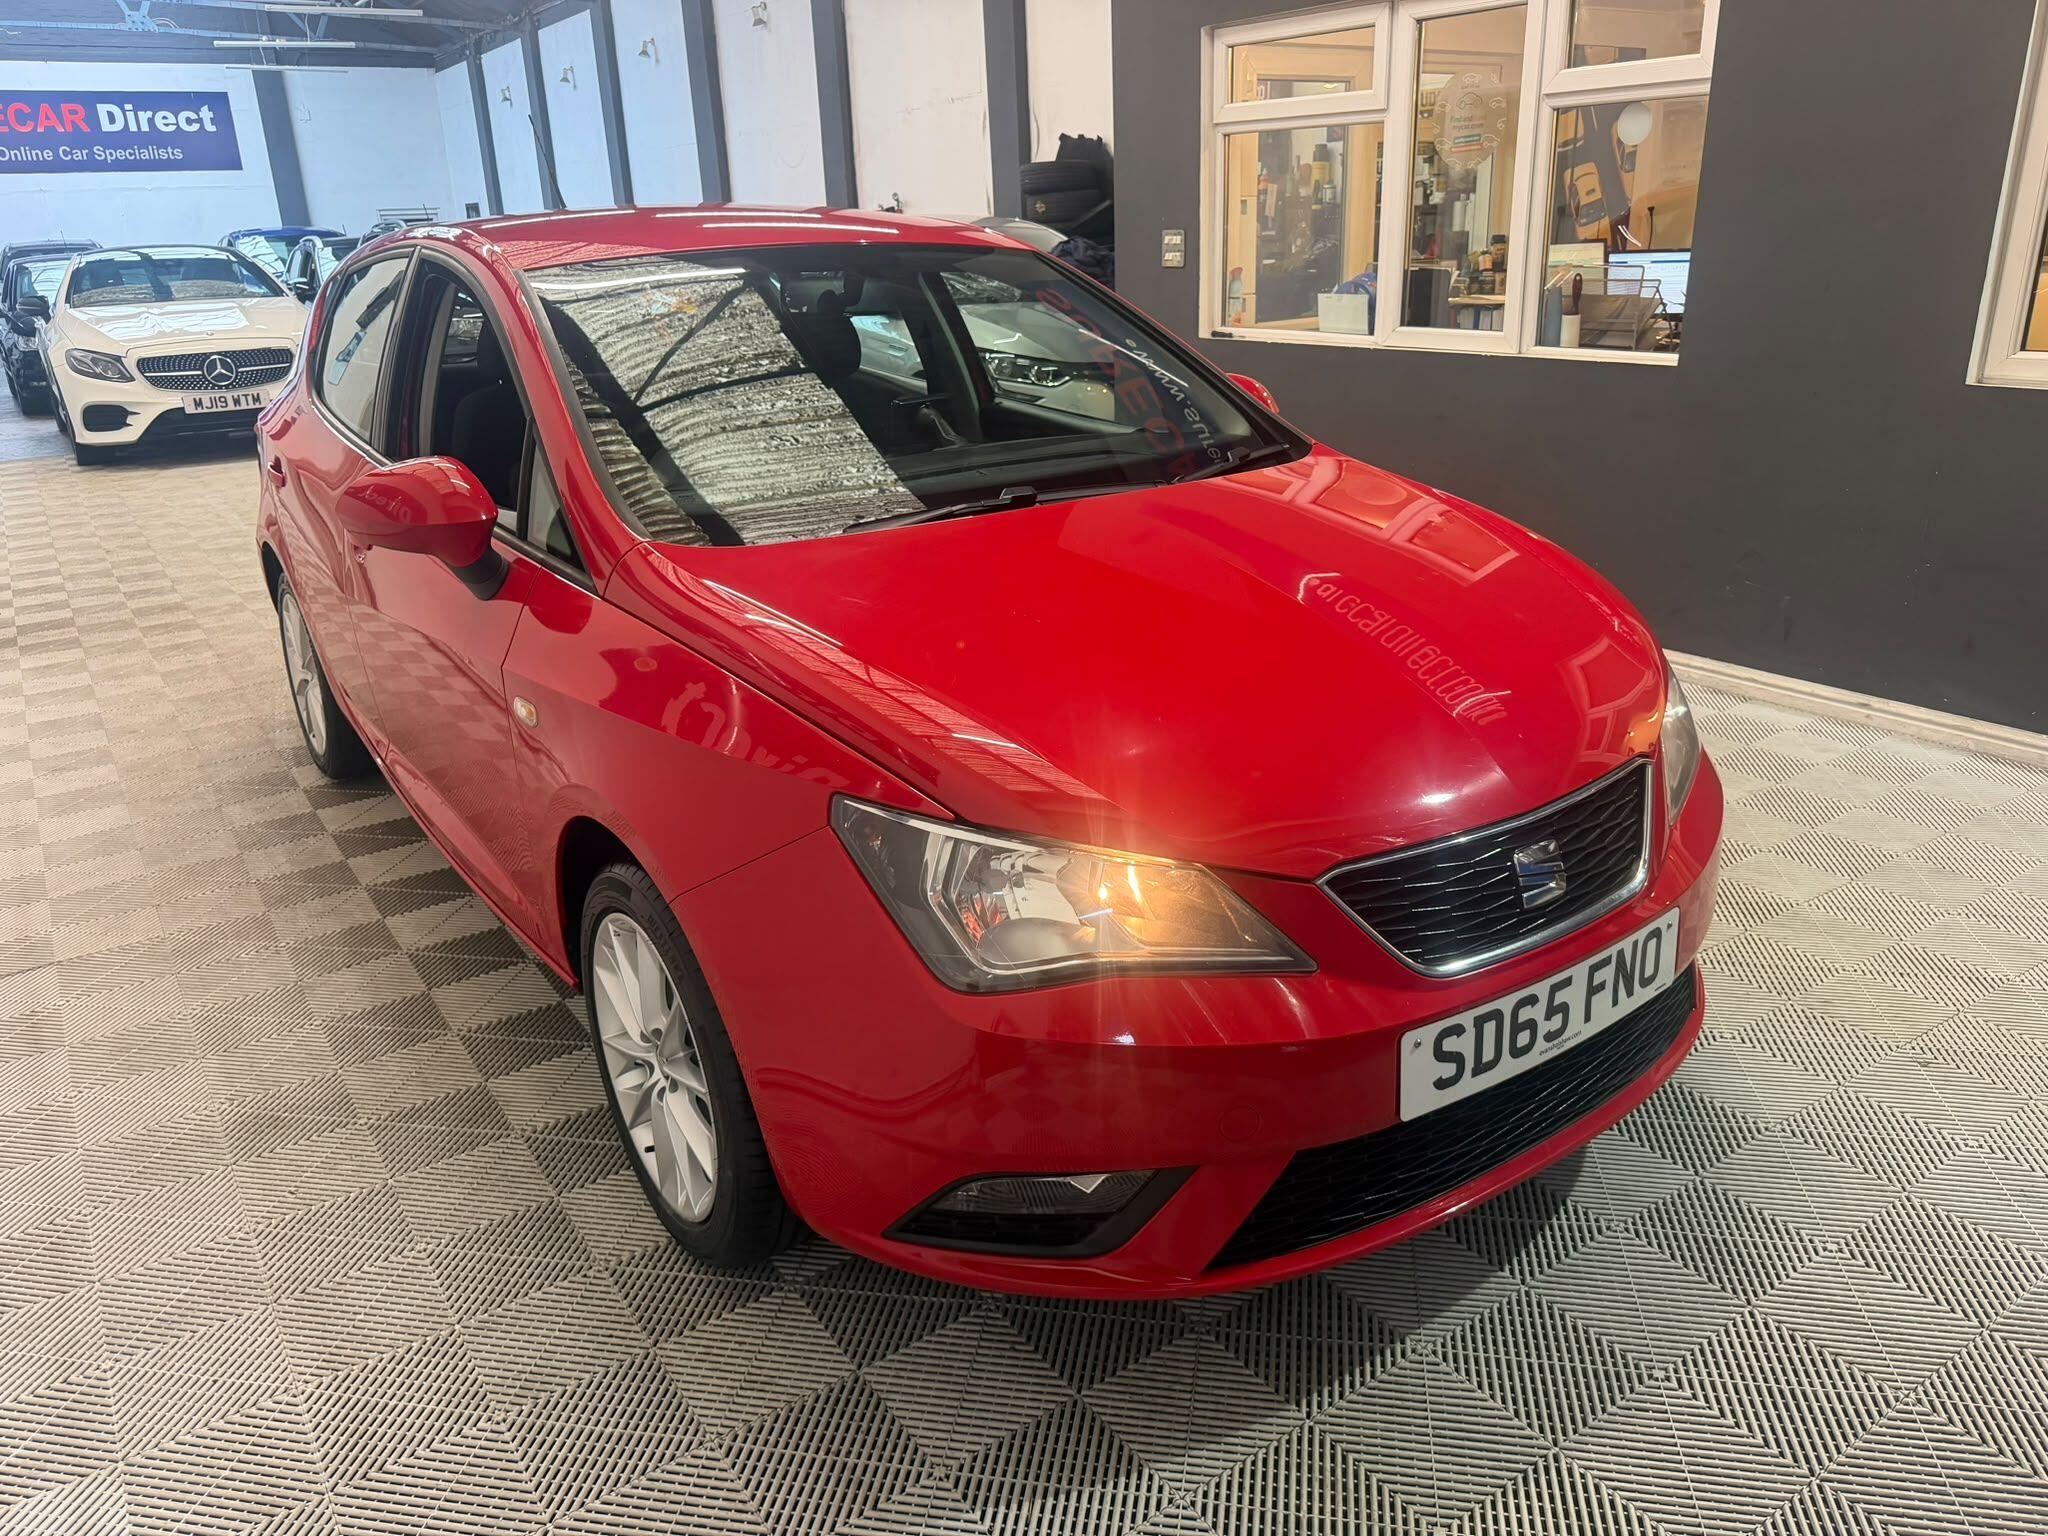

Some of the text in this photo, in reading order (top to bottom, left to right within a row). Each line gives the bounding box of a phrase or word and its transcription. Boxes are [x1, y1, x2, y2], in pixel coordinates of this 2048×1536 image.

[96, 104, 217, 133] Direct
[0, 146, 184, 163] Online Car Specialists
[193, 392, 262, 411] MJ19 WTM
[1432, 926, 1663, 1091] SD65 FNO
